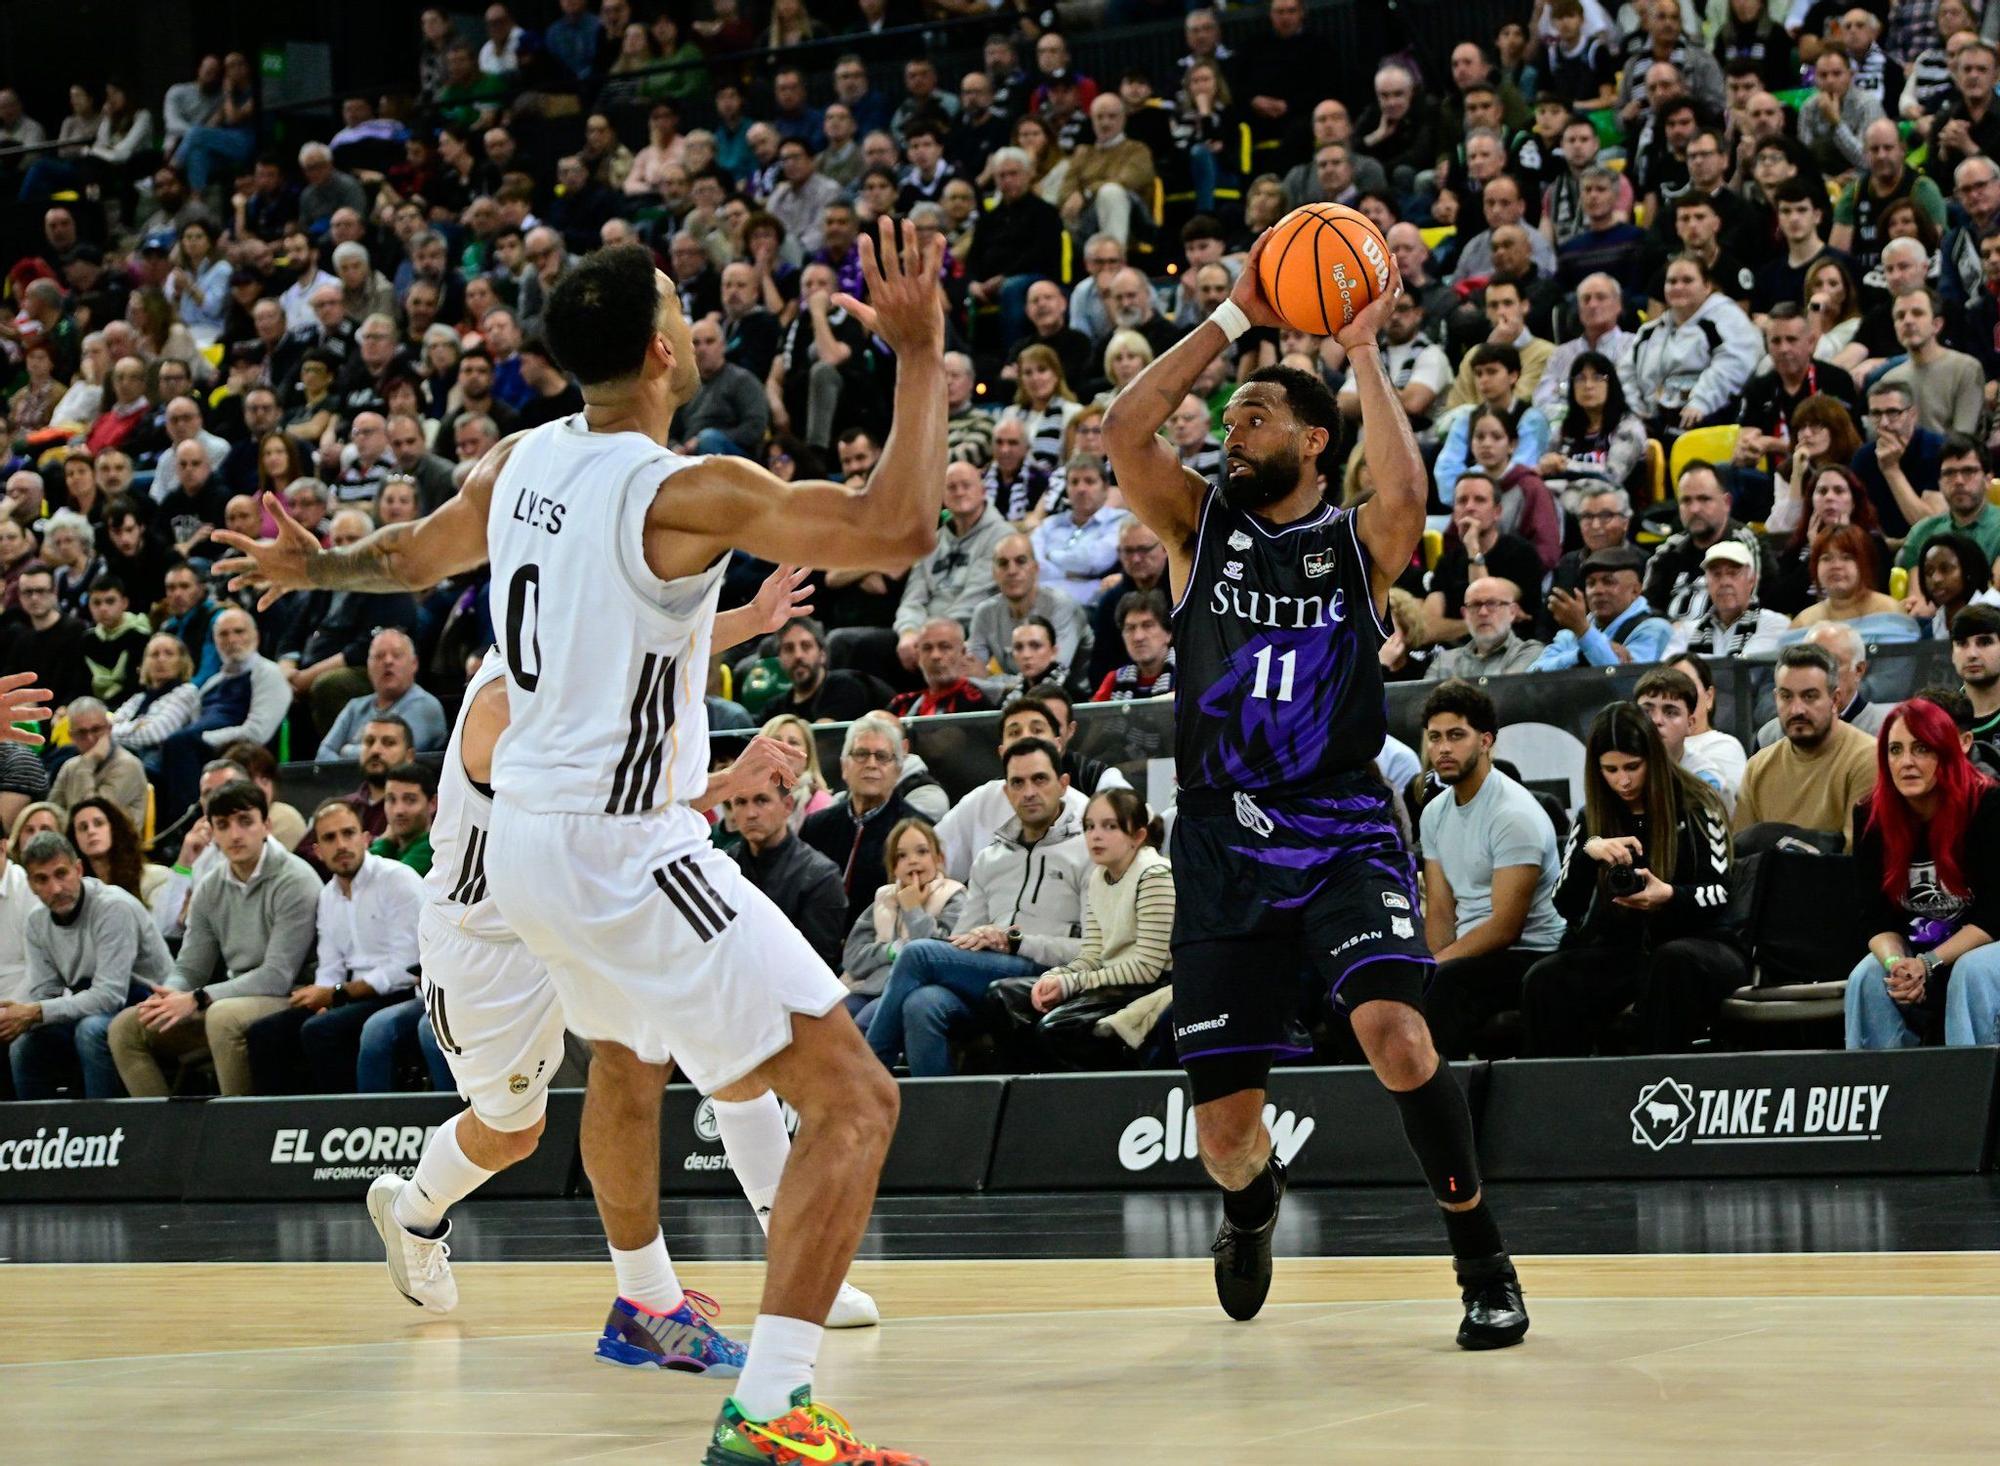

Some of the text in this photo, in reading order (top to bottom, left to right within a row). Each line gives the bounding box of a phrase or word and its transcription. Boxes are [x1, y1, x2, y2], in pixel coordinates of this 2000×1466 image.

[506, 563, 542, 693] 0
[1251, 644, 1296, 702] 11
[1697, 1084, 1890, 1135] TAKE A BUEY
[270, 1128, 315, 1164] EL
